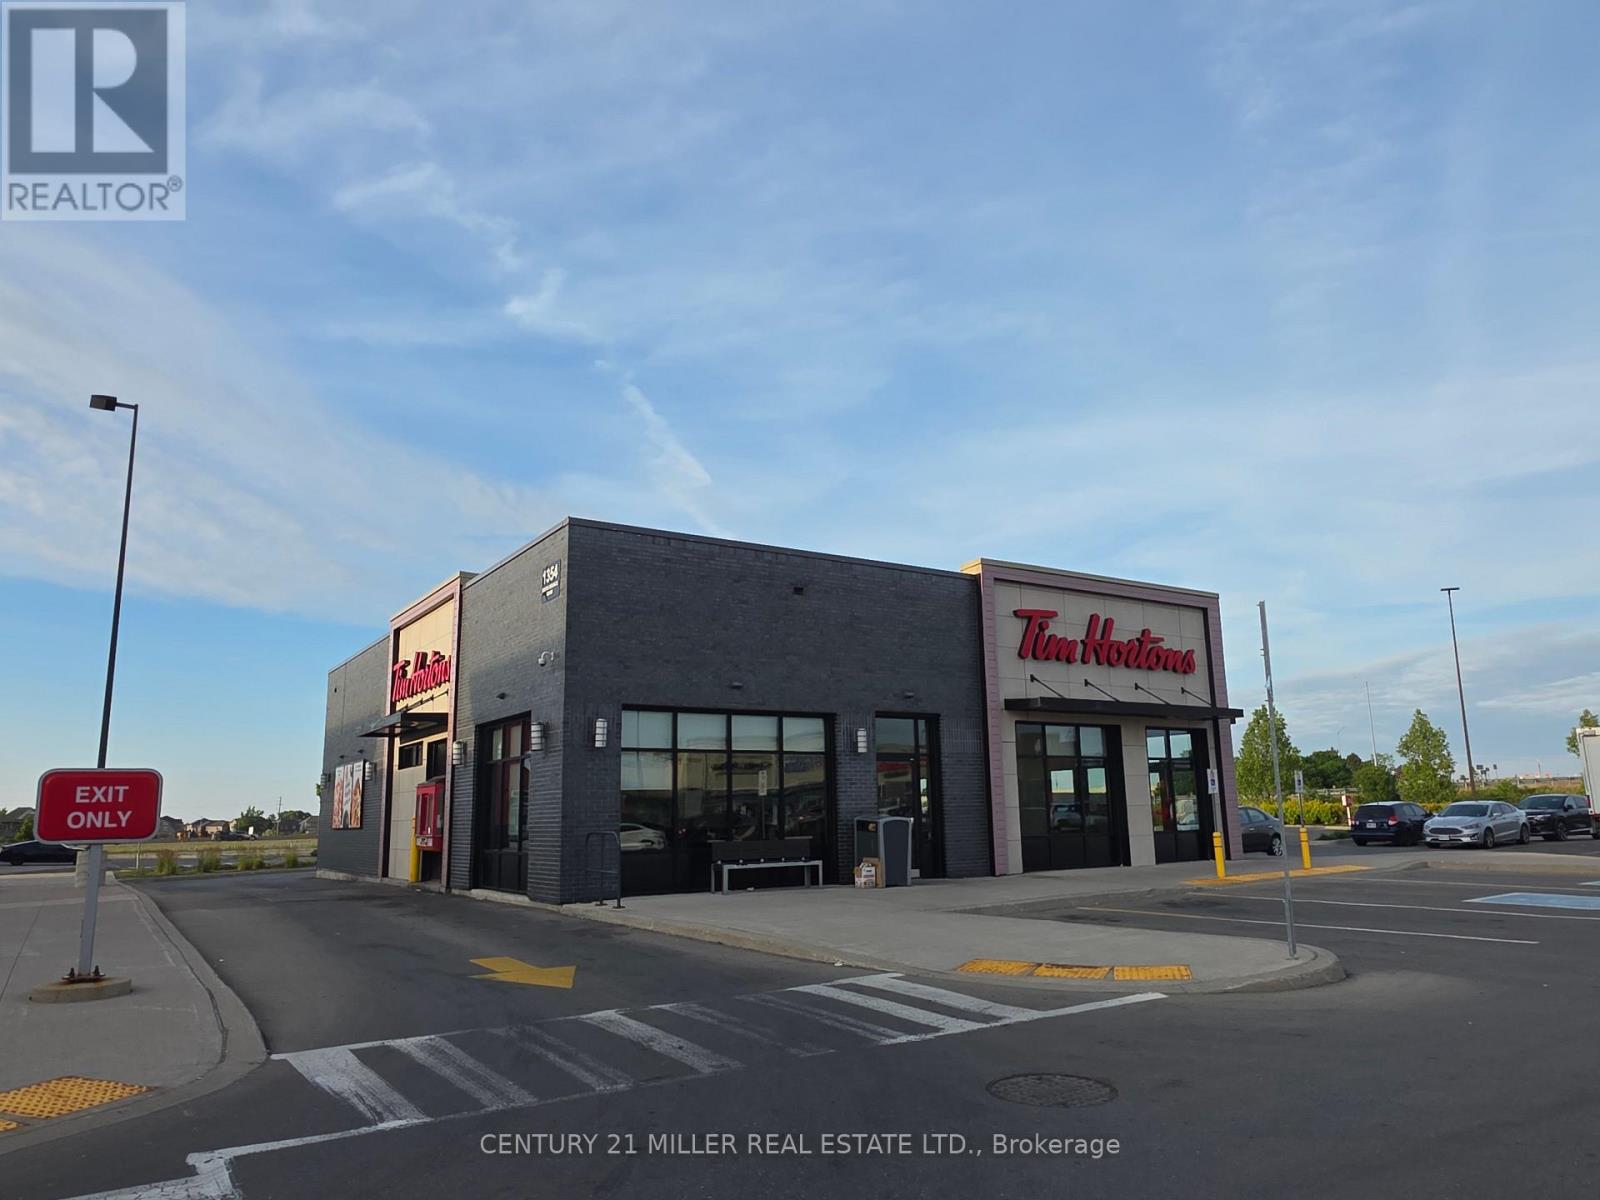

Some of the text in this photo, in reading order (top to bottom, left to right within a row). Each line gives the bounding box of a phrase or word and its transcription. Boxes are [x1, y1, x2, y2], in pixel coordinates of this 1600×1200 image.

[1014, 609, 1196, 674] Tim Hortons
[391, 659, 412, 702] Tim
[75, 785, 129, 803] EXIT
[66, 810, 132, 829] ONLY
